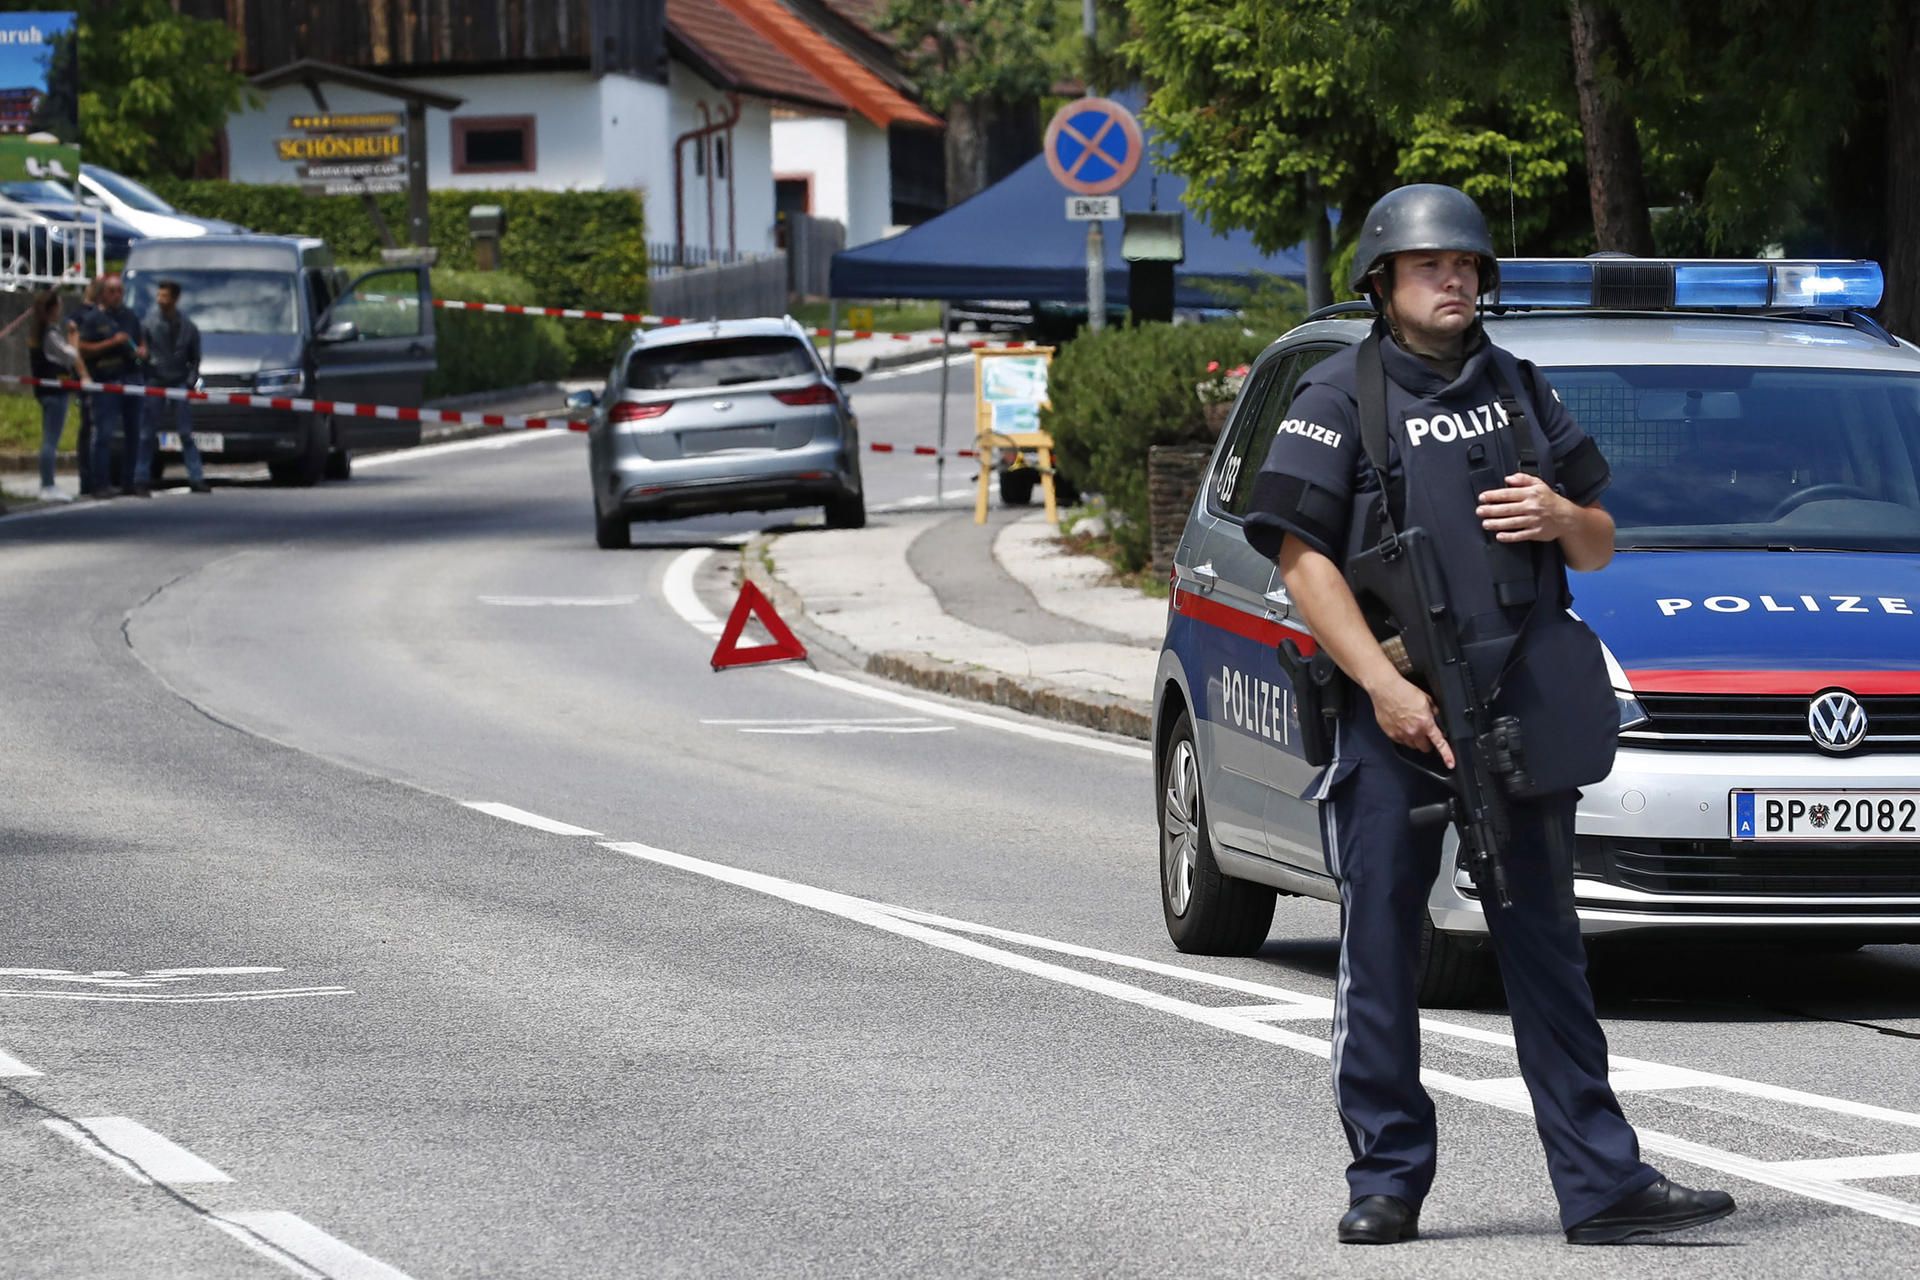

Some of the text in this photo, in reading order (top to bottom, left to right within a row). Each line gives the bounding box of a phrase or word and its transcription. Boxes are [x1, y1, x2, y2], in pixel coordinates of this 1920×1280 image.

[280, 135, 399, 160] SCHÖNRUH
[1074, 200, 1111, 216] ENDE
[1276, 419, 1342, 448] POLIZEI
[1220, 455, 1242, 502] 133
[1656, 595, 1914, 616] POLIZE
[1222, 665, 1289, 746] POLIZEI
[1810, 693, 1867, 748] VW
[1741, 799, 1917, 832] A BP 2082
